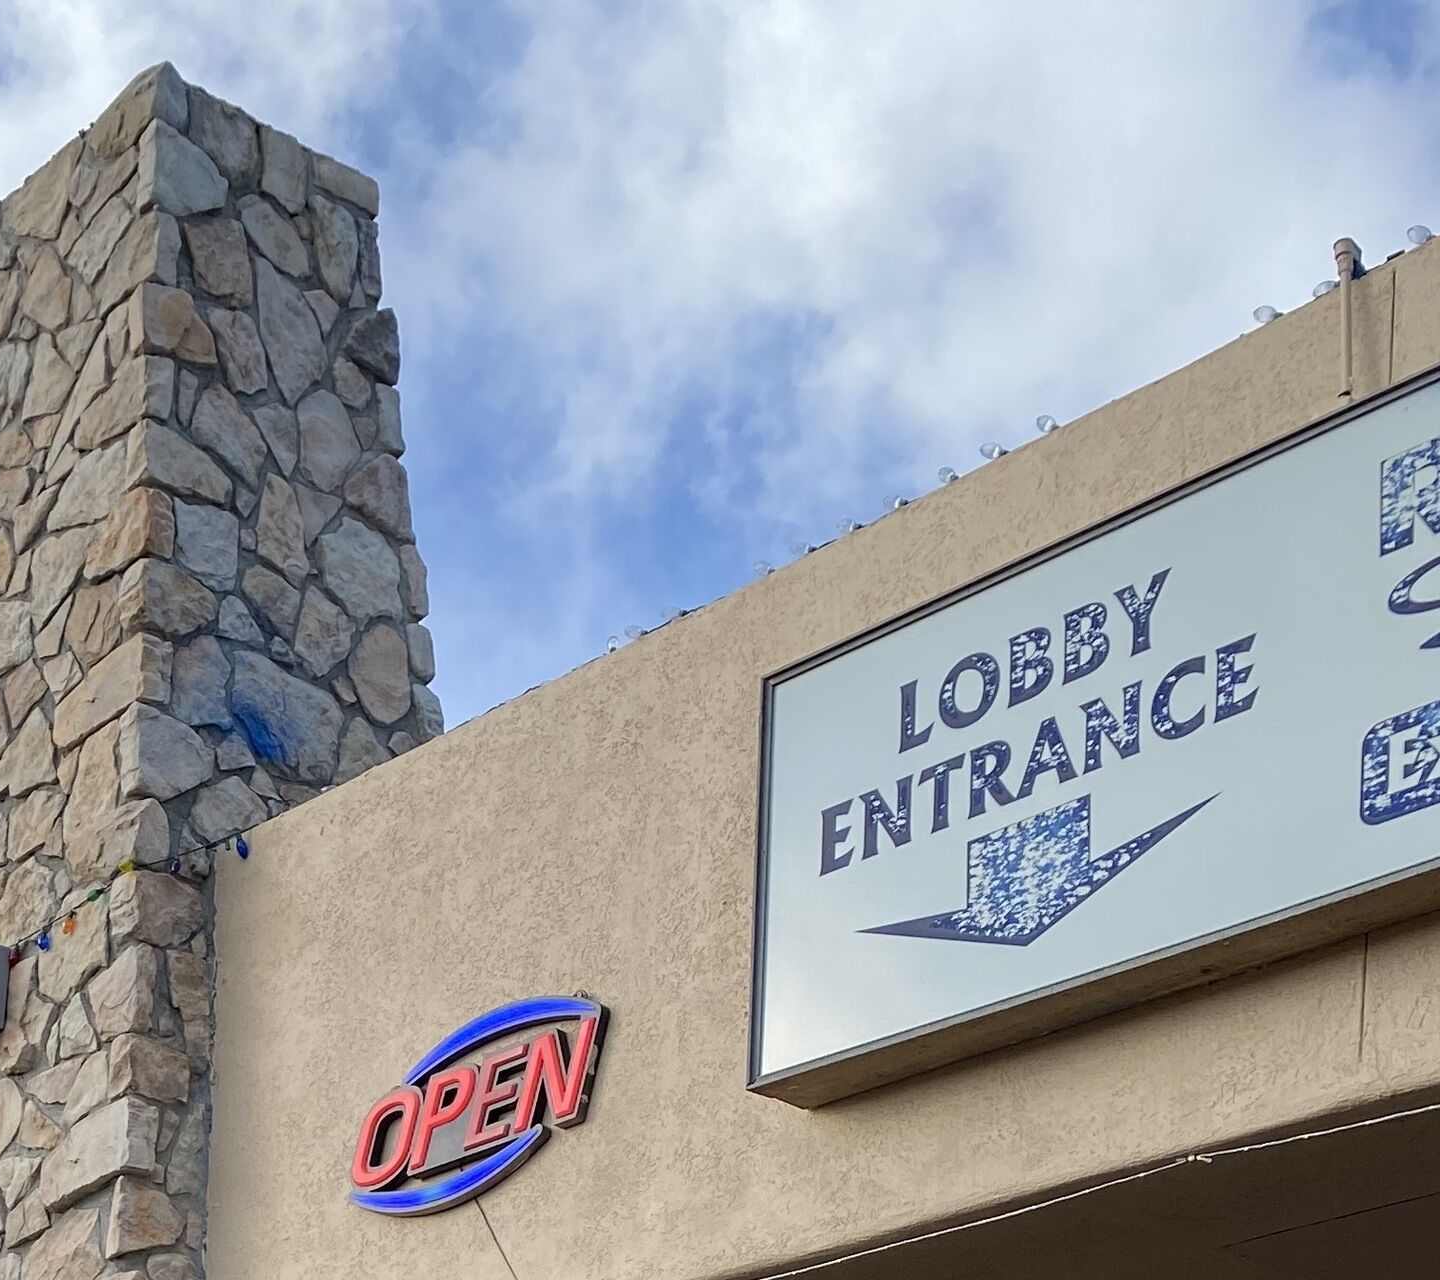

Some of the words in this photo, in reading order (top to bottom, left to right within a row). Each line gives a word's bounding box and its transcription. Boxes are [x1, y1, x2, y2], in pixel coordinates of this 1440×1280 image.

[899, 567, 1172, 753] LOBBY
[819, 633, 1260, 876] ENTRANCE
[352, 1017, 597, 1187] OPEN
